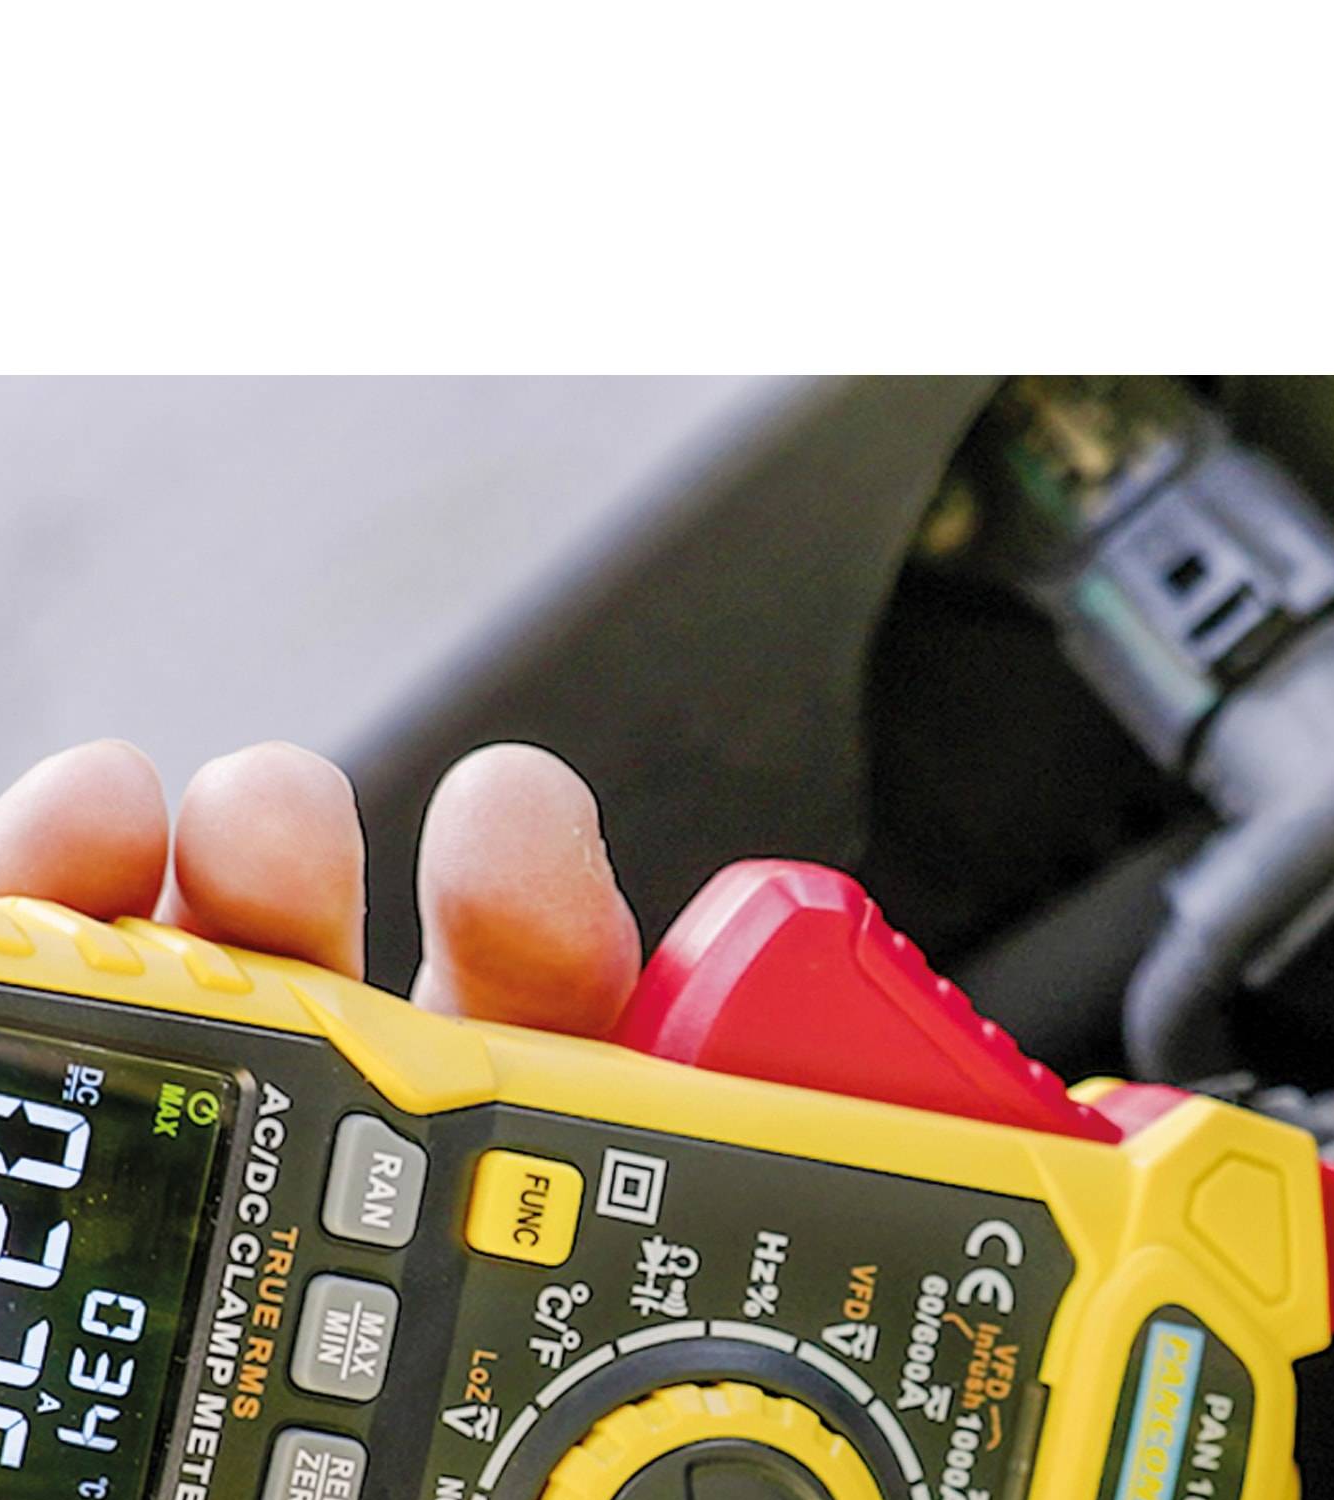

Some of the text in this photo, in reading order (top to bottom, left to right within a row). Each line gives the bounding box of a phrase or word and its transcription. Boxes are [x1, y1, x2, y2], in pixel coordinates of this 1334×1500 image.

[76, 1065, 105, 1106] DC
[154, 1083, 187, 1137] MAX
[238, 1082, 291, 1224] AC/DC
[360, 1151, 403, 1229] RAN
[512, 1173, 551, 1247] FUNC
[743, 1231, 789, 1318] Hz%
[844, 1266, 876, 1320] VFD
[205, 1244, 260, 1385] CLAMP
[232, 1230, 298, 1418] TRUE RMS
[317, 1309, 352, 1365] MIN
[349, 1311, 386, 1377] MAX
[896, 1275, 949, 1414] 60/600A
[36, 1391, 61, 1413] A
[57, 1290, 146, 1451] 034
[464, 1350, 496, 1403] LoZ
[963, 1323, 999, 1409] Inrush
[982, 1346, 1017, 1399] VFD
[1192, 1394, 1233, 1470] PAN
